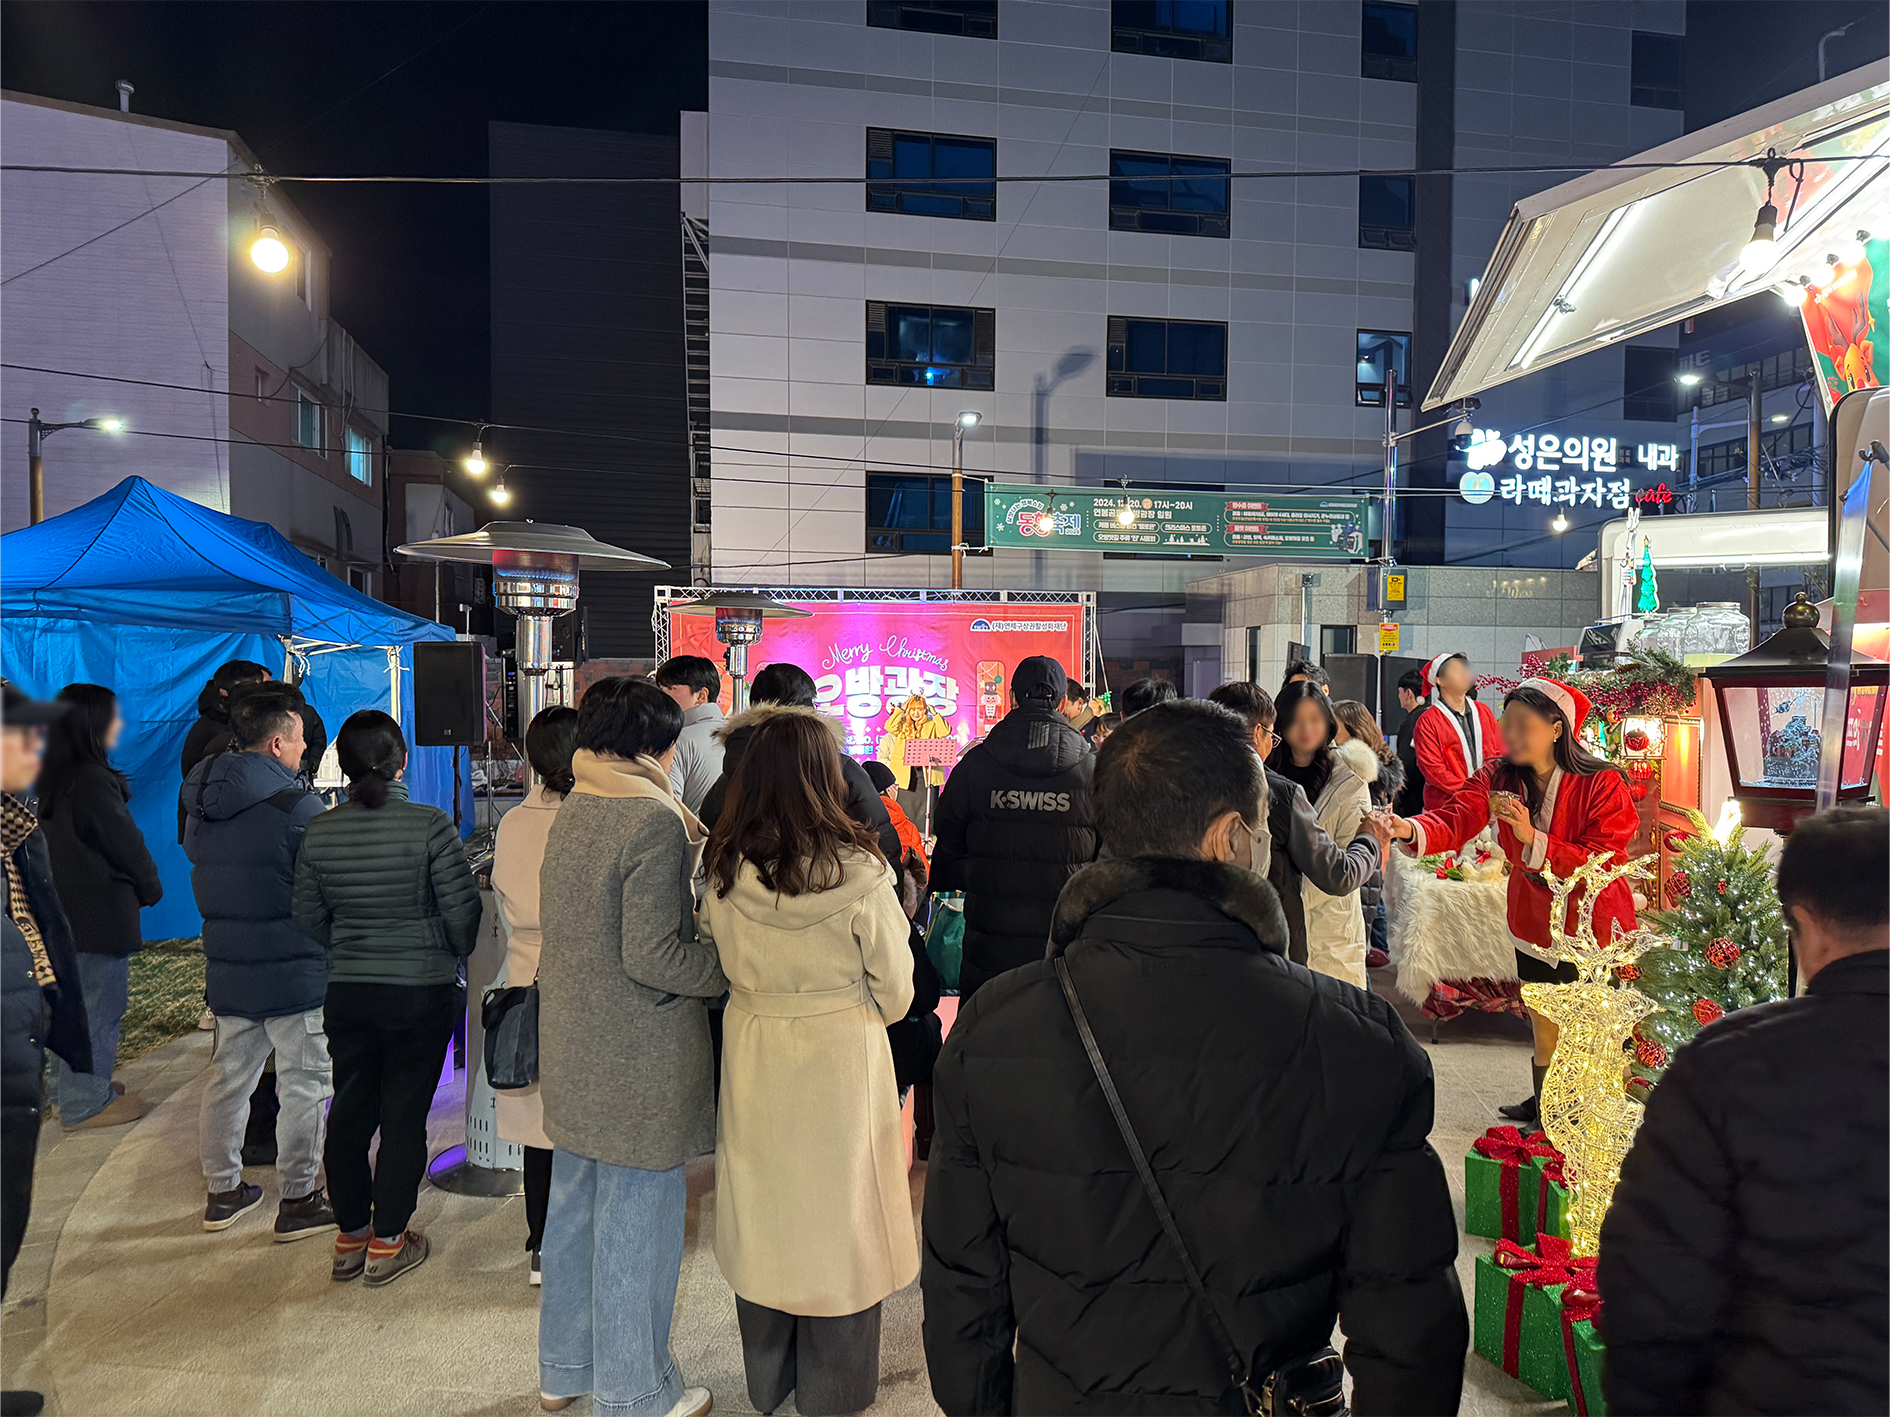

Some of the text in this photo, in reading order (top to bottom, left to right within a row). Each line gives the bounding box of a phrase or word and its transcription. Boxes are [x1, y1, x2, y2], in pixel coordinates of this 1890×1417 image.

[1508, 434, 1617, 472] 성은의원
[1637, 443, 1680, 472] 내과
[1094, 498, 1115, 506] 2024.
[1130, 500, 1142, 508] 20.
[1154, 501, 1193, 510] 17시~20시
[1500, 474, 1630, 509] 라떼과자점
[1635, 483, 1673, 504] cafe
[822, 635, 949, 671] Merry Christmas
[814, 666, 959, 718] 오방광장
